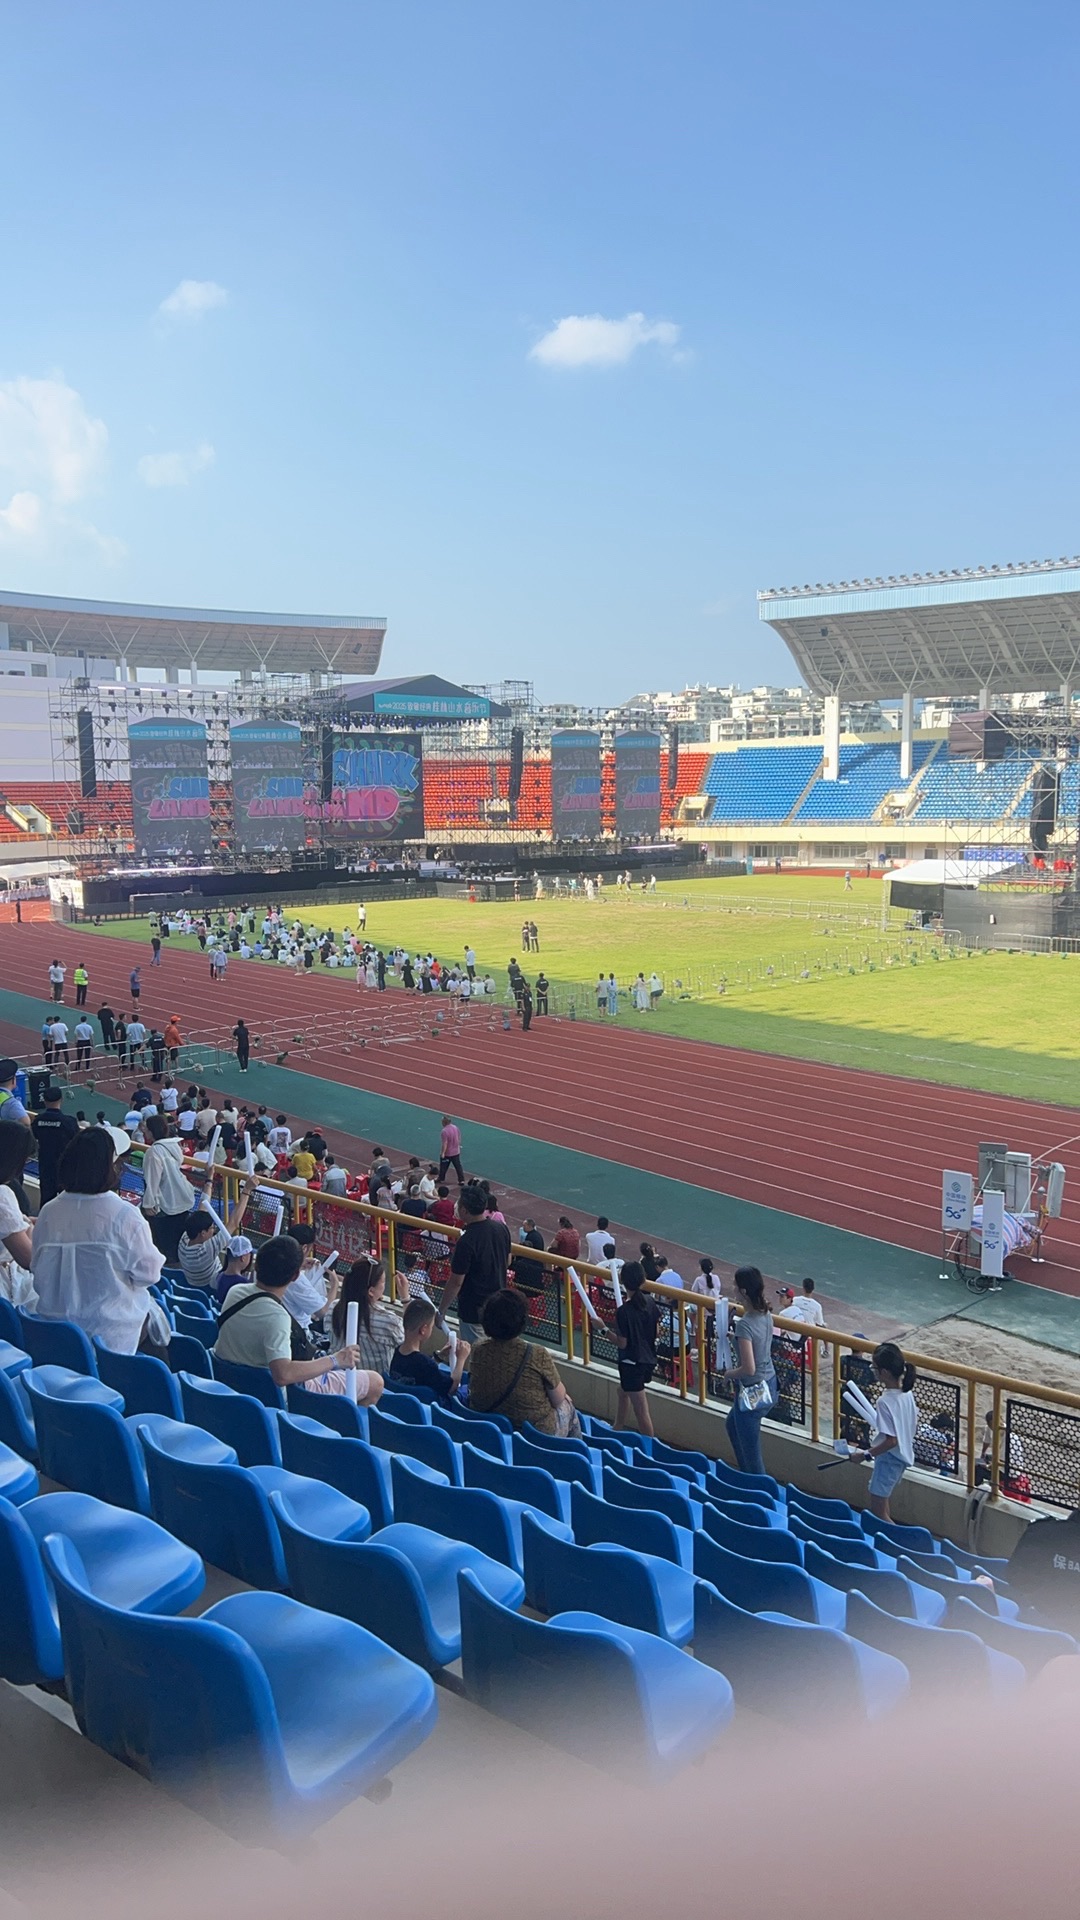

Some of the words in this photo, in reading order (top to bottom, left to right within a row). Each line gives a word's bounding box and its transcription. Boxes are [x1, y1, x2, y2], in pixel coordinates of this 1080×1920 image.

[332, 748, 420, 793] SHARK
[148, 798, 211, 820] LAND
[247, 797, 304, 818] LAND
